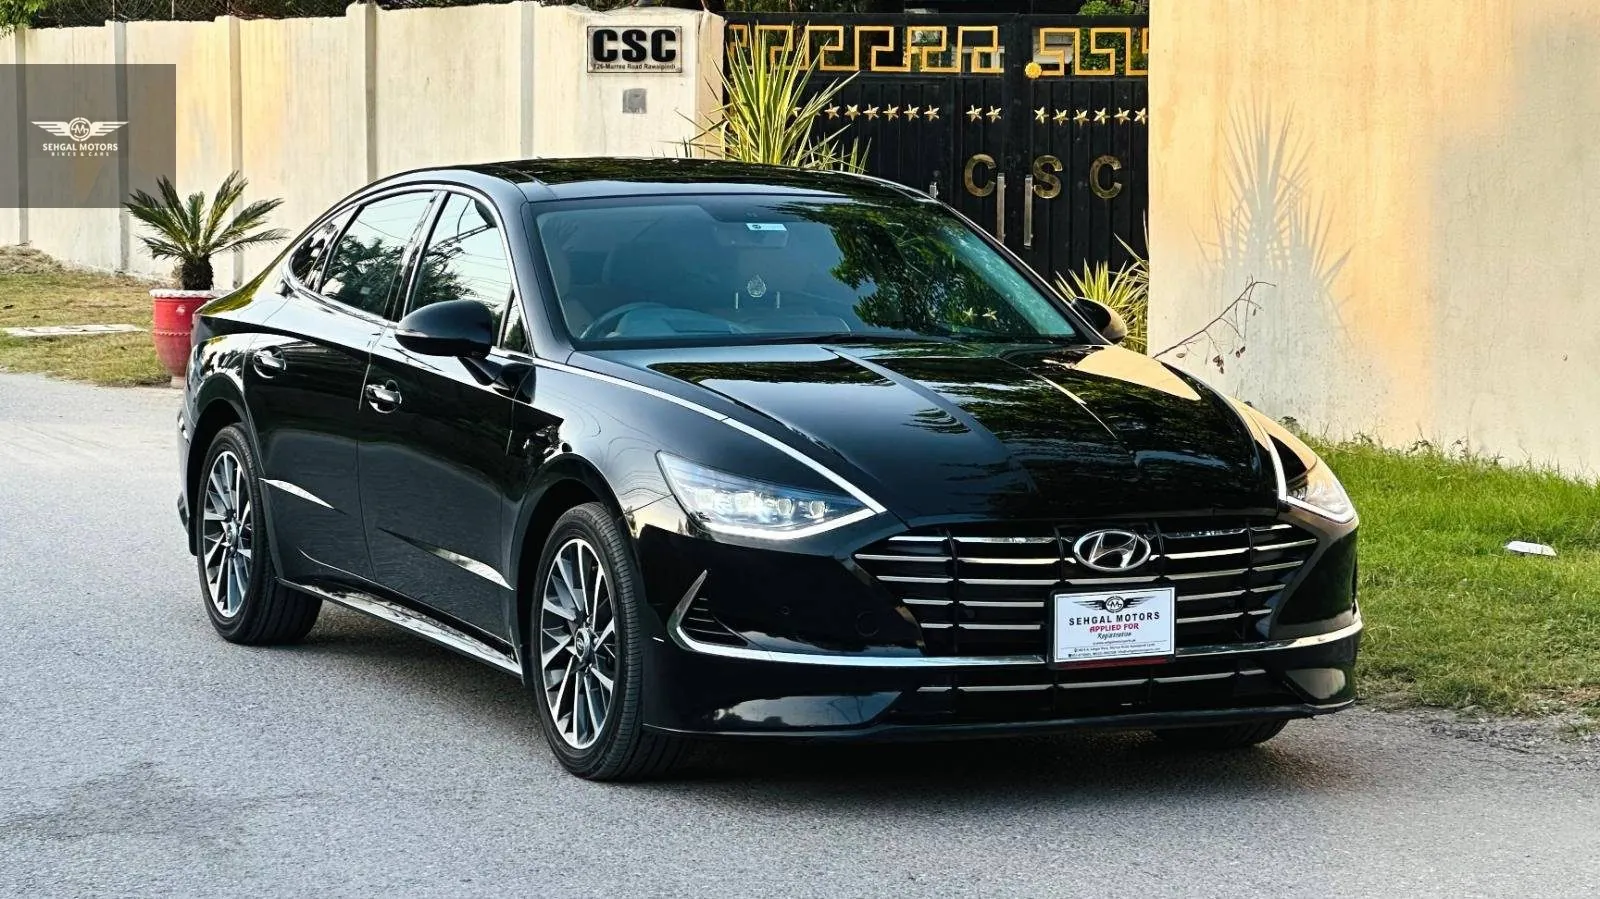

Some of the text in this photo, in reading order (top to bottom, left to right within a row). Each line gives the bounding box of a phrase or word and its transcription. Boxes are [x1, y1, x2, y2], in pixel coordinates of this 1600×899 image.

[593, 29, 676, 62] CSC
[1069, 611, 1160, 626] SEHGAL MOTORS
[1090, 622, 1139, 633] APPLIED FOR
